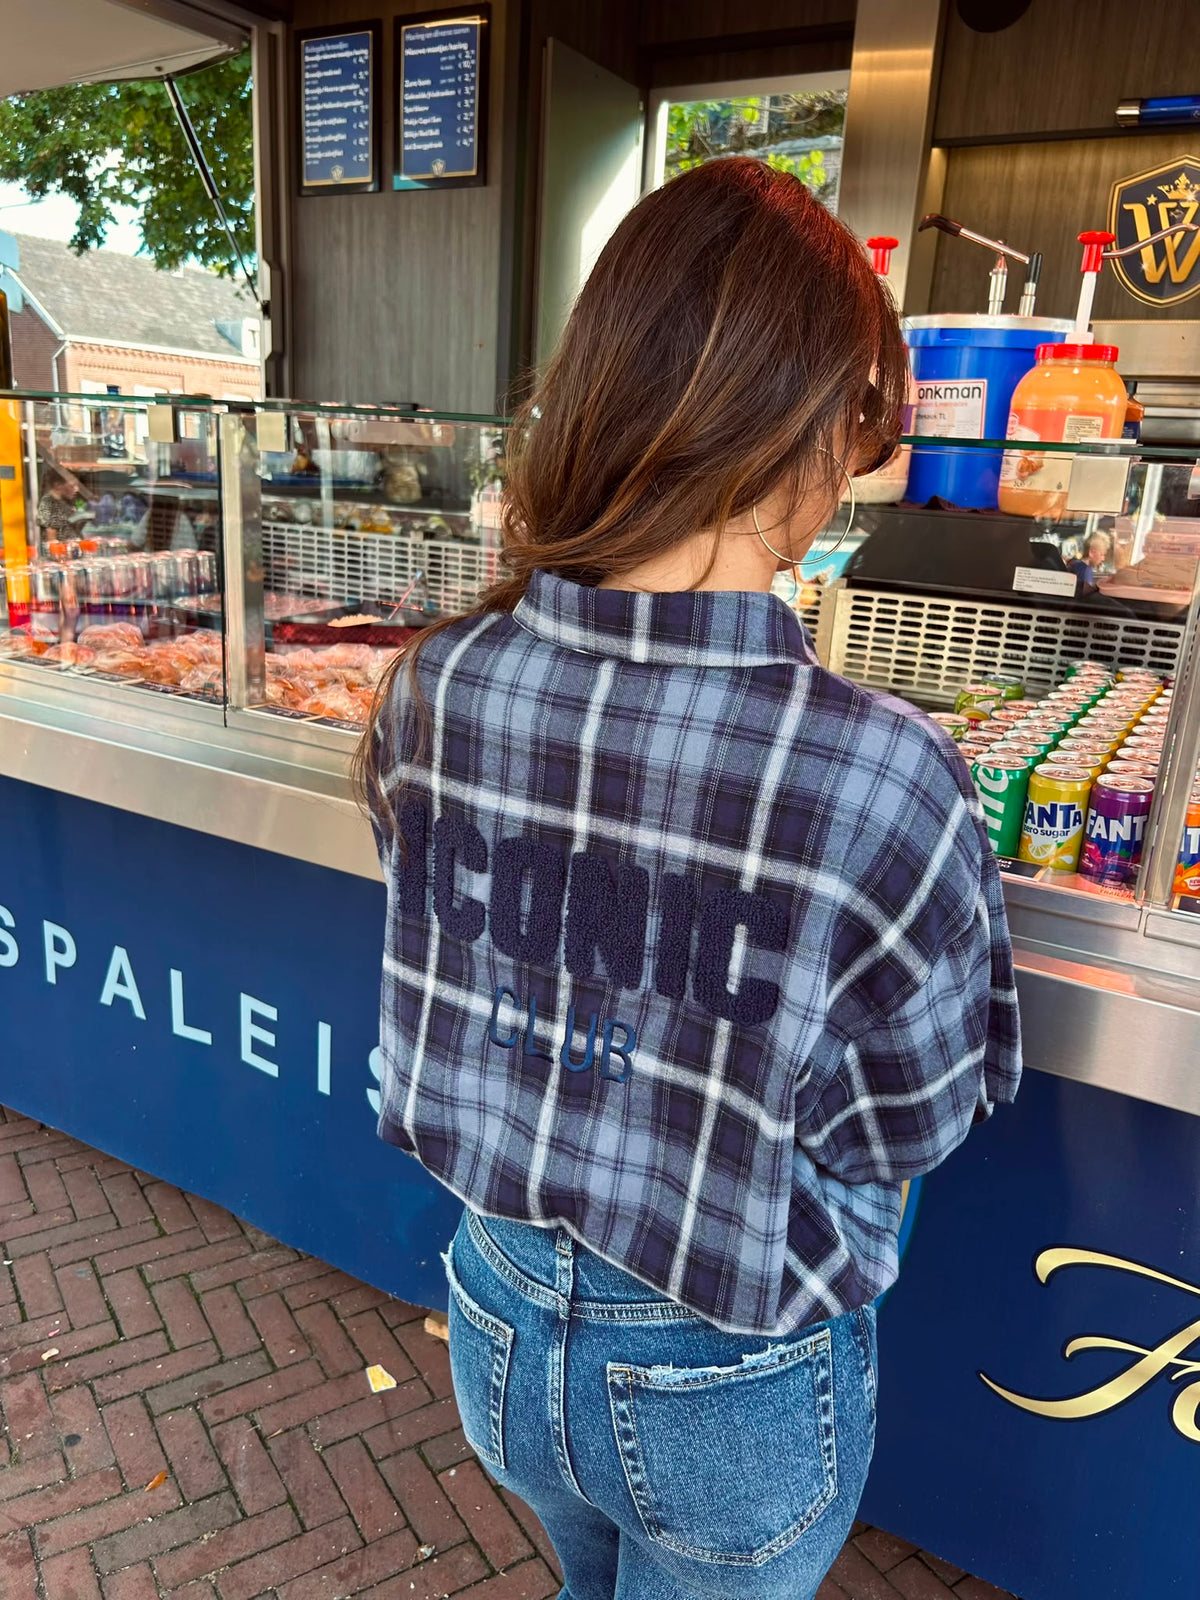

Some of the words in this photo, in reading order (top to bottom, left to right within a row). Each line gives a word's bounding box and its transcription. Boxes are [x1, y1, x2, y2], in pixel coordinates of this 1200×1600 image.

[918, 385, 982, 400] onkman
[1024, 802, 1084, 830] ANTA
[1040, 828, 1071, 838] sugar
[397, 798, 790, 1027] ICONIC
[488, 985, 637, 1084] CLUB
